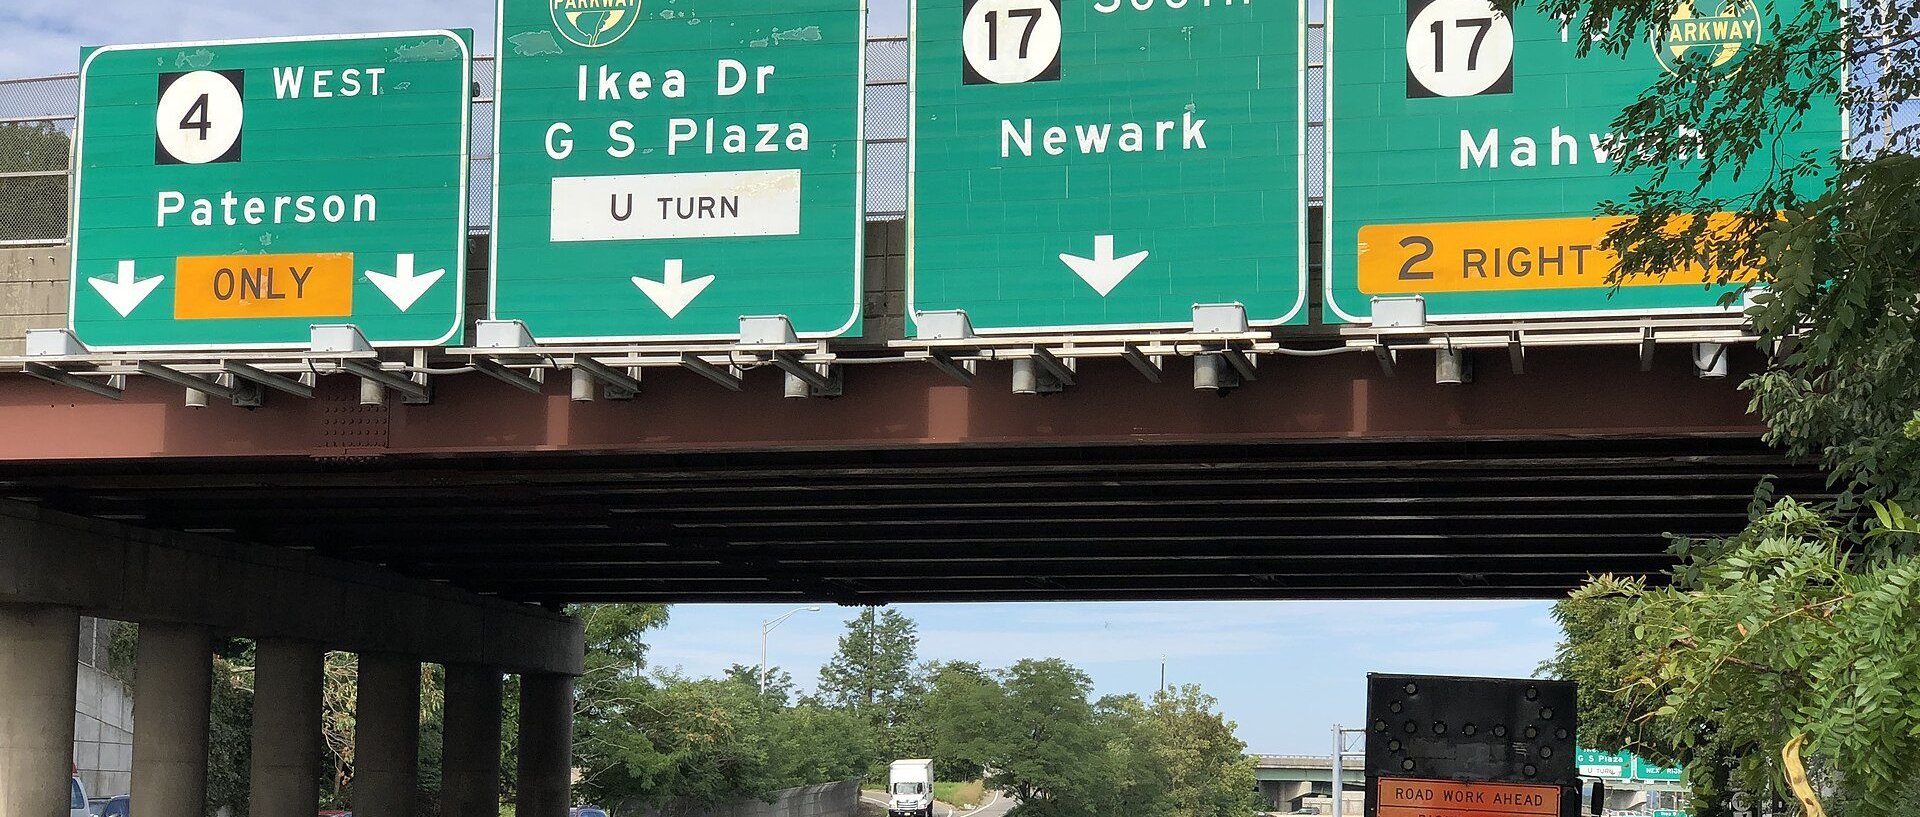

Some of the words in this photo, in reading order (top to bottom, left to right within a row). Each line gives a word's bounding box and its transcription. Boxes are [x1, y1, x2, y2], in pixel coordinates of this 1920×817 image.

[984, 8, 1042, 61] 17
[1430, 17, 1493, 73] 17
[1655, 19, 1756, 43] ARKWAY
[577, 64, 686, 101] Ikea
[717, 59, 775, 96] Dr
[179, 93, 212, 141] 4
[273, 65, 386, 100] WEST
[545, 122, 574, 160] G
[607, 120, 636, 158] S
[668, 117, 809, 156] Plaza
[1001, 111, 1208, 158] Newark
[157, 190, 377, 228] Paterson
[610, 193, 633, 221] U
[657, 195, 739, 220] TURN
[1398, 236, 1434, 281] 2
[1463, 245, 1592, 279] RIGHT
[214, 266, 313, 301] ONLY
[1577, 754, 1584, 762] G
[1588, 754, 1595, 762] S
[1598, 755, 1624, 763] Plaza
[1395, 787, 1434, 801] ROAD
[1443, 790, 1485, 804] WORK
[1493, 793, 1544, 807] AHEAD
